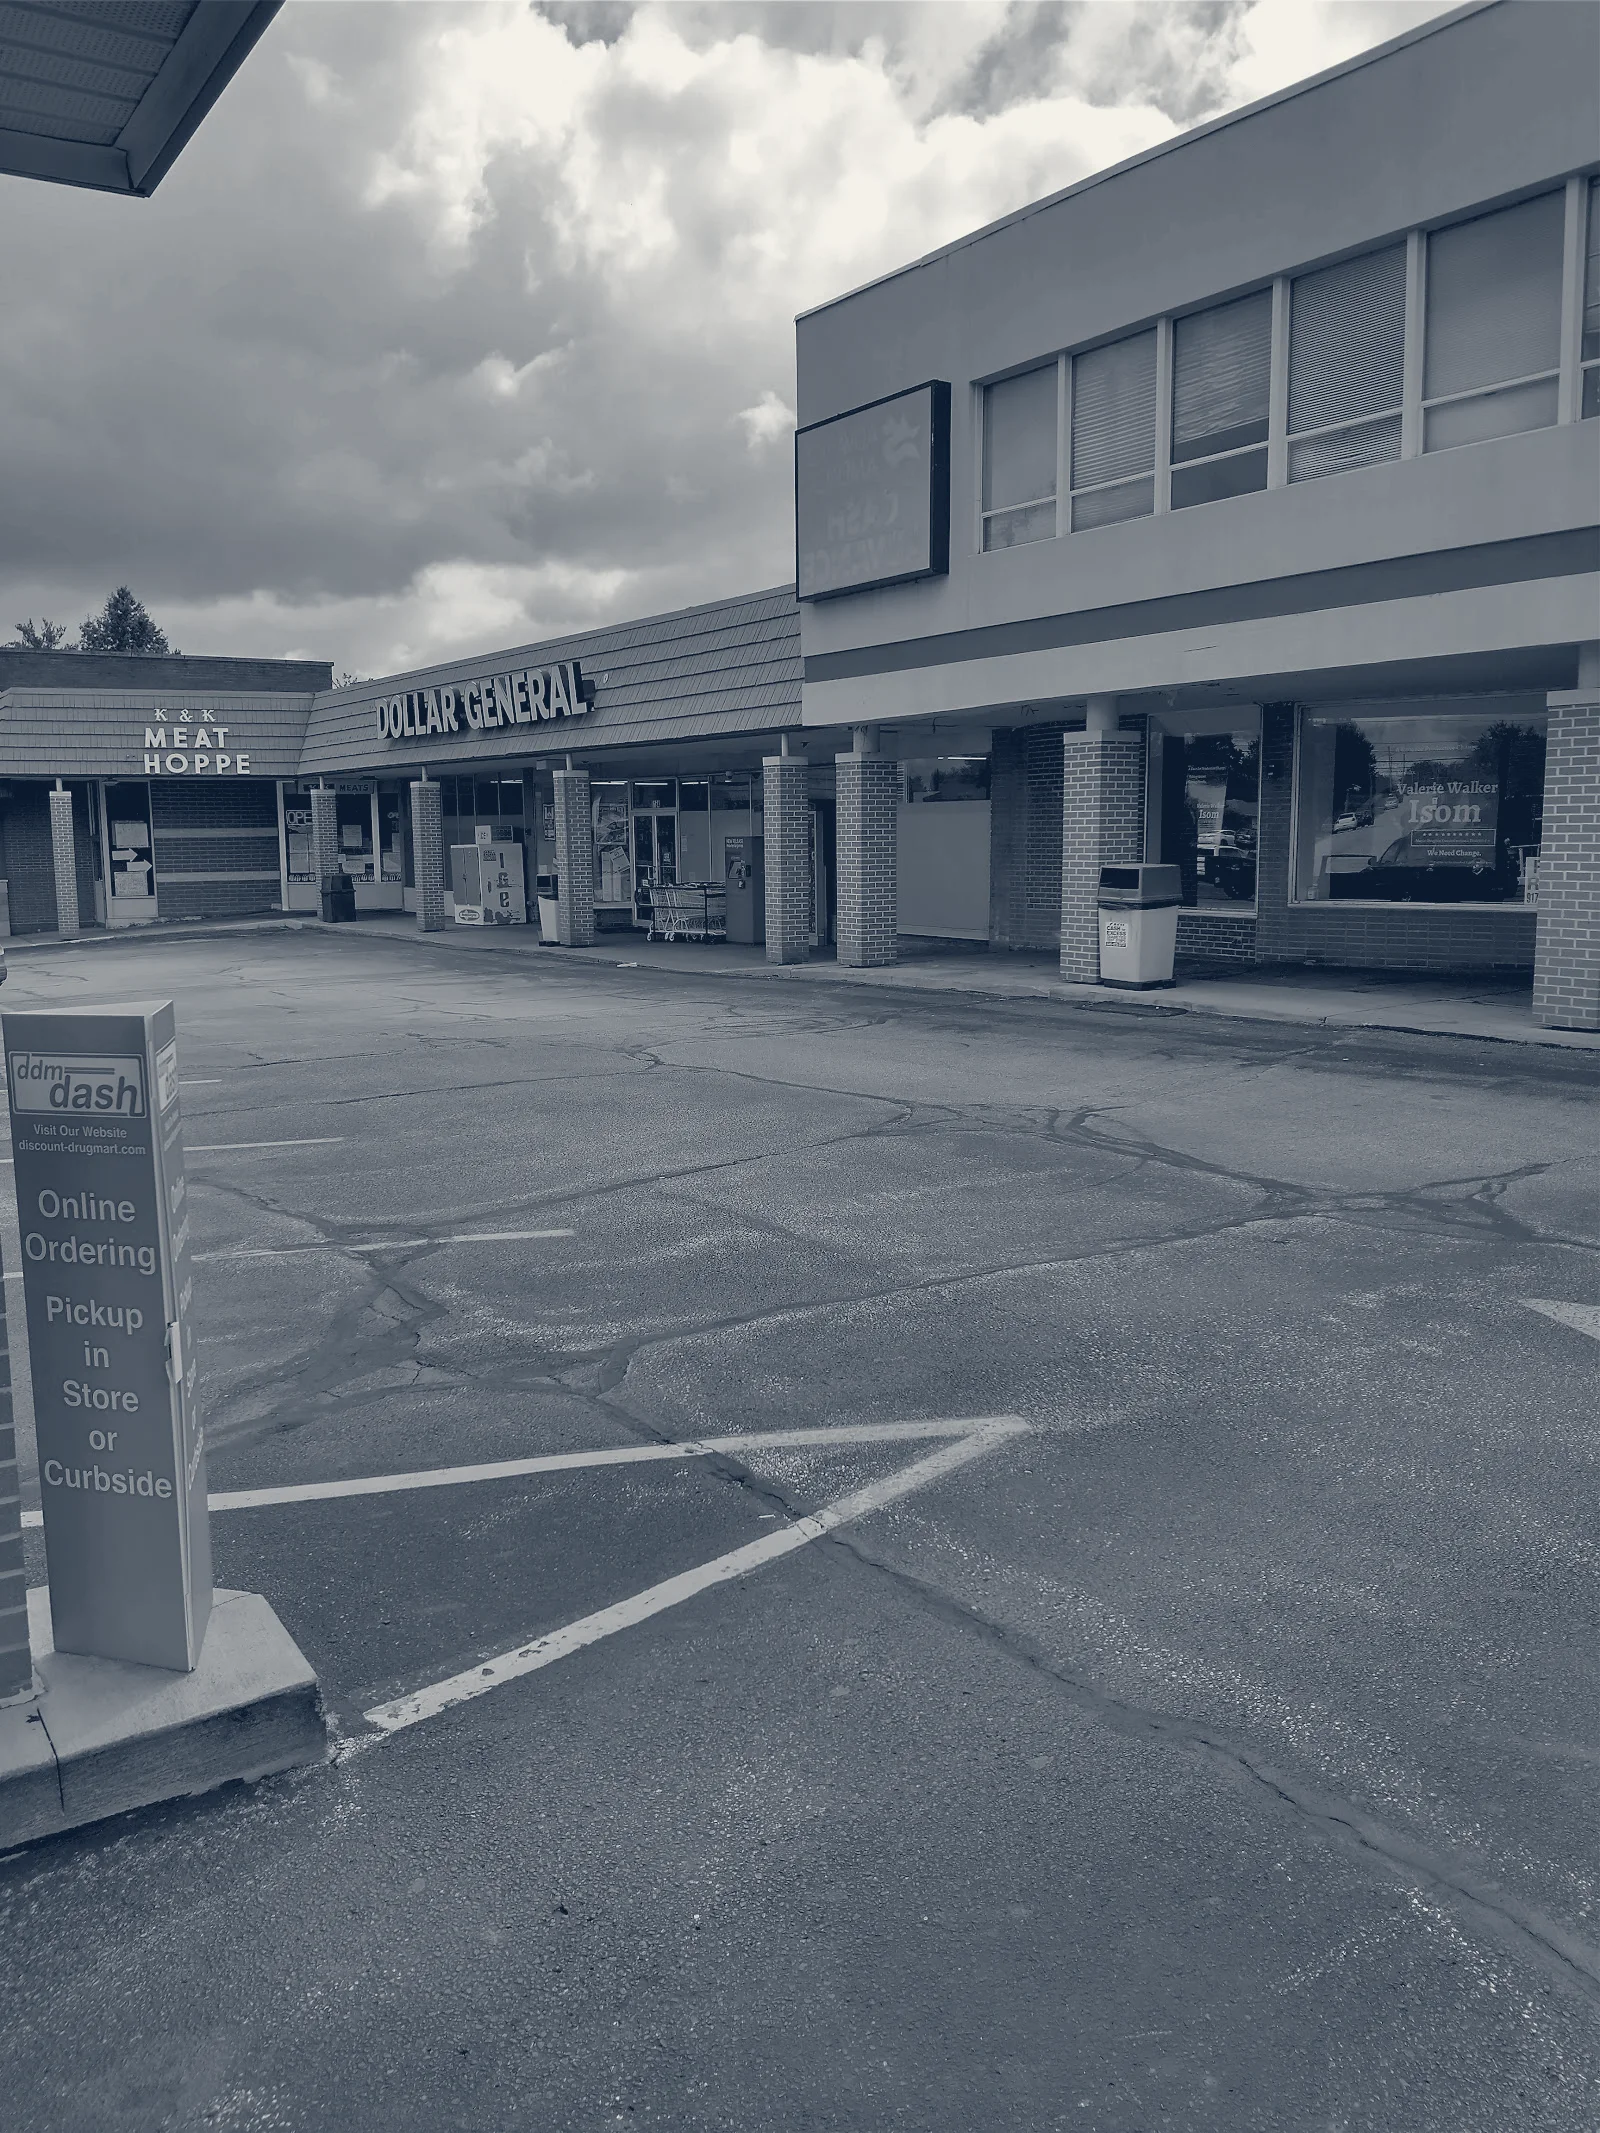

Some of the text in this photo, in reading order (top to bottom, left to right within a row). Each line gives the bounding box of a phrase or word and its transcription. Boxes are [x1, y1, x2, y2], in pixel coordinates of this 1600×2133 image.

[375, 662, 588, 739] DOLLAR GENERAL
[154, 708, 217, 723] K & K
[144, 727, 229, 749] MEAT
[144, 753, 251, 774] HOPPE
[339, 784, 369, 792] MEATS
[1397, 780, 1498, 795] Valerie Walker
[287, 811, 312, 824] OPE
[1408, 800, 1481, 823] Isom
[17, 1056, 63, 1081] ddm
[49, 1074, 138, 1113] dash
[33, 1123, 128, 1139] Visit Our Website
[18, 1140, 147, 1156] discount-drugmart.com
[37, 1188, 136, 1223] Online
[25, 1231, 157, 1276] Ordering
[45, 1295, 144, 1336] Pickup
[84, 1340, 110, 1369] in
[63, 1379, 140, 1413] Store
[88, 1428, 118, 1453] or
[43, 1459, 173, 1500] Curbside
